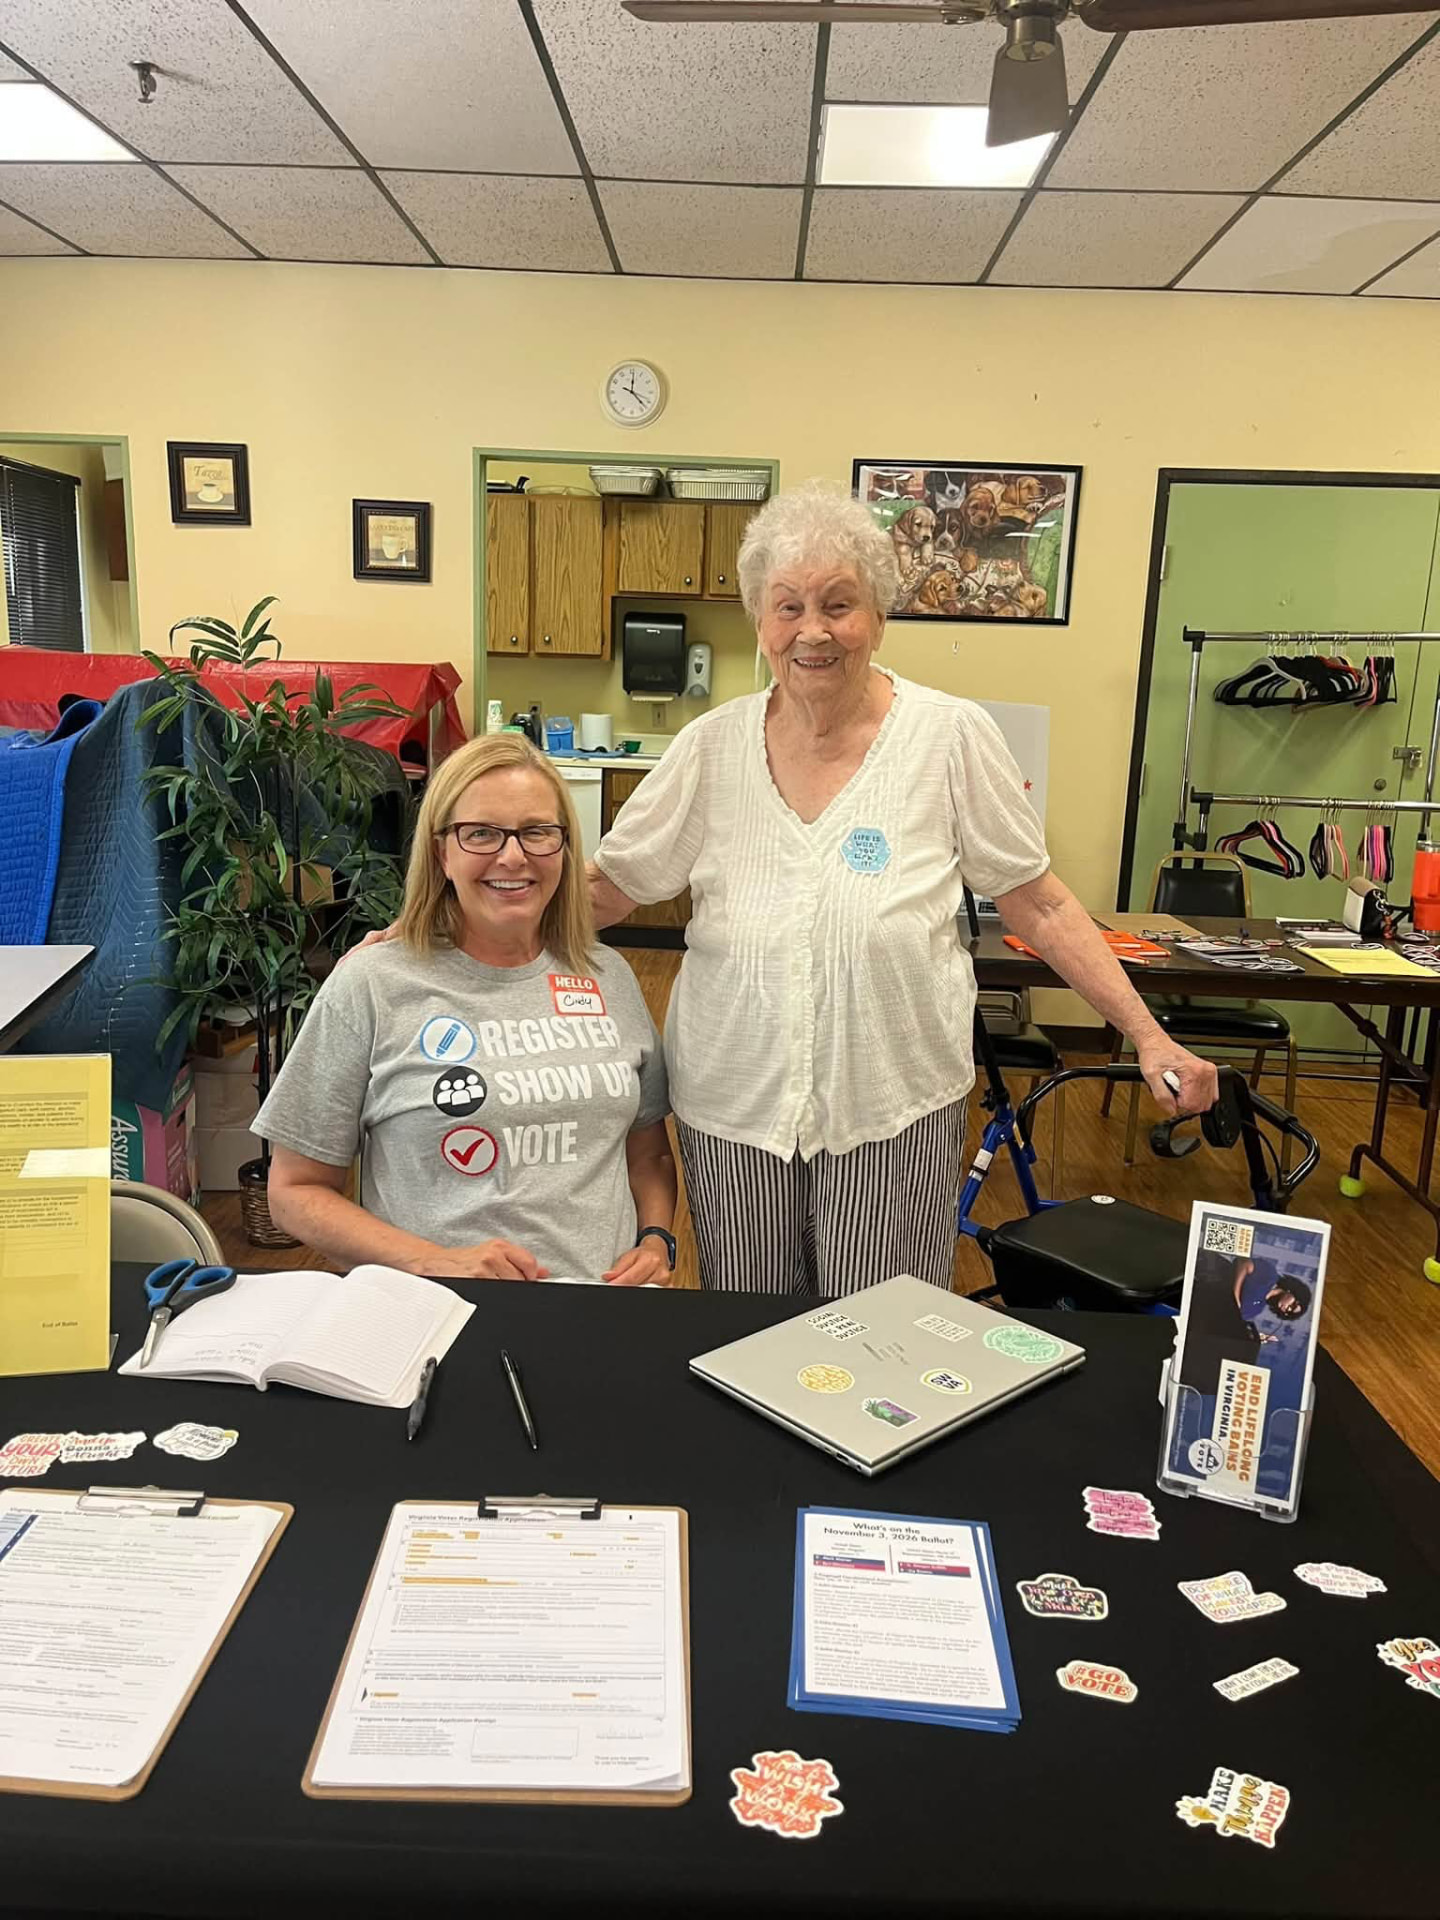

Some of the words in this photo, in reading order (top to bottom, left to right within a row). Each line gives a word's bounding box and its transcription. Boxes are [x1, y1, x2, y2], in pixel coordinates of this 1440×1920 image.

[554, 976, 593, 990] HELLO
[478, 1015, 621, 1057] REGISTER
[494, 1064, 593, 1105] SHOW
[597, 1061, 633, 1098] UP
[502, 1121, 578, 1168] VOTE
[1226, 1368, 1236, 1383] IN
[1249, 1374, 1262, 1405] END
[1231, 1371, 1249, 1427] VOTING
[1197, 1443, 1205, 1468] VOTE
[1226, 1431, 1241, 1472] BANS
[1239, 1410, 1257, 1482] LIFELONG
[824, 1527, 876, 1539] November
[892, 1533, 918, 1543] 2026
[921, 1535, 954, 1545] Ballot?
[852, 1521, 887, 1532] What's
[904, 1526, 920, 1534] the
[1066, 1672, 1130, 1696] VOTE
[1075, 1666, 1122, 1683] #GO
[763, 1766, 824, 1797] WISH
[1209, 1769, 1235, 1813] MAKE
[744, 1788, 817, 1823] WORK
[1254, 1784, 1287, 1844] HAPPEN
